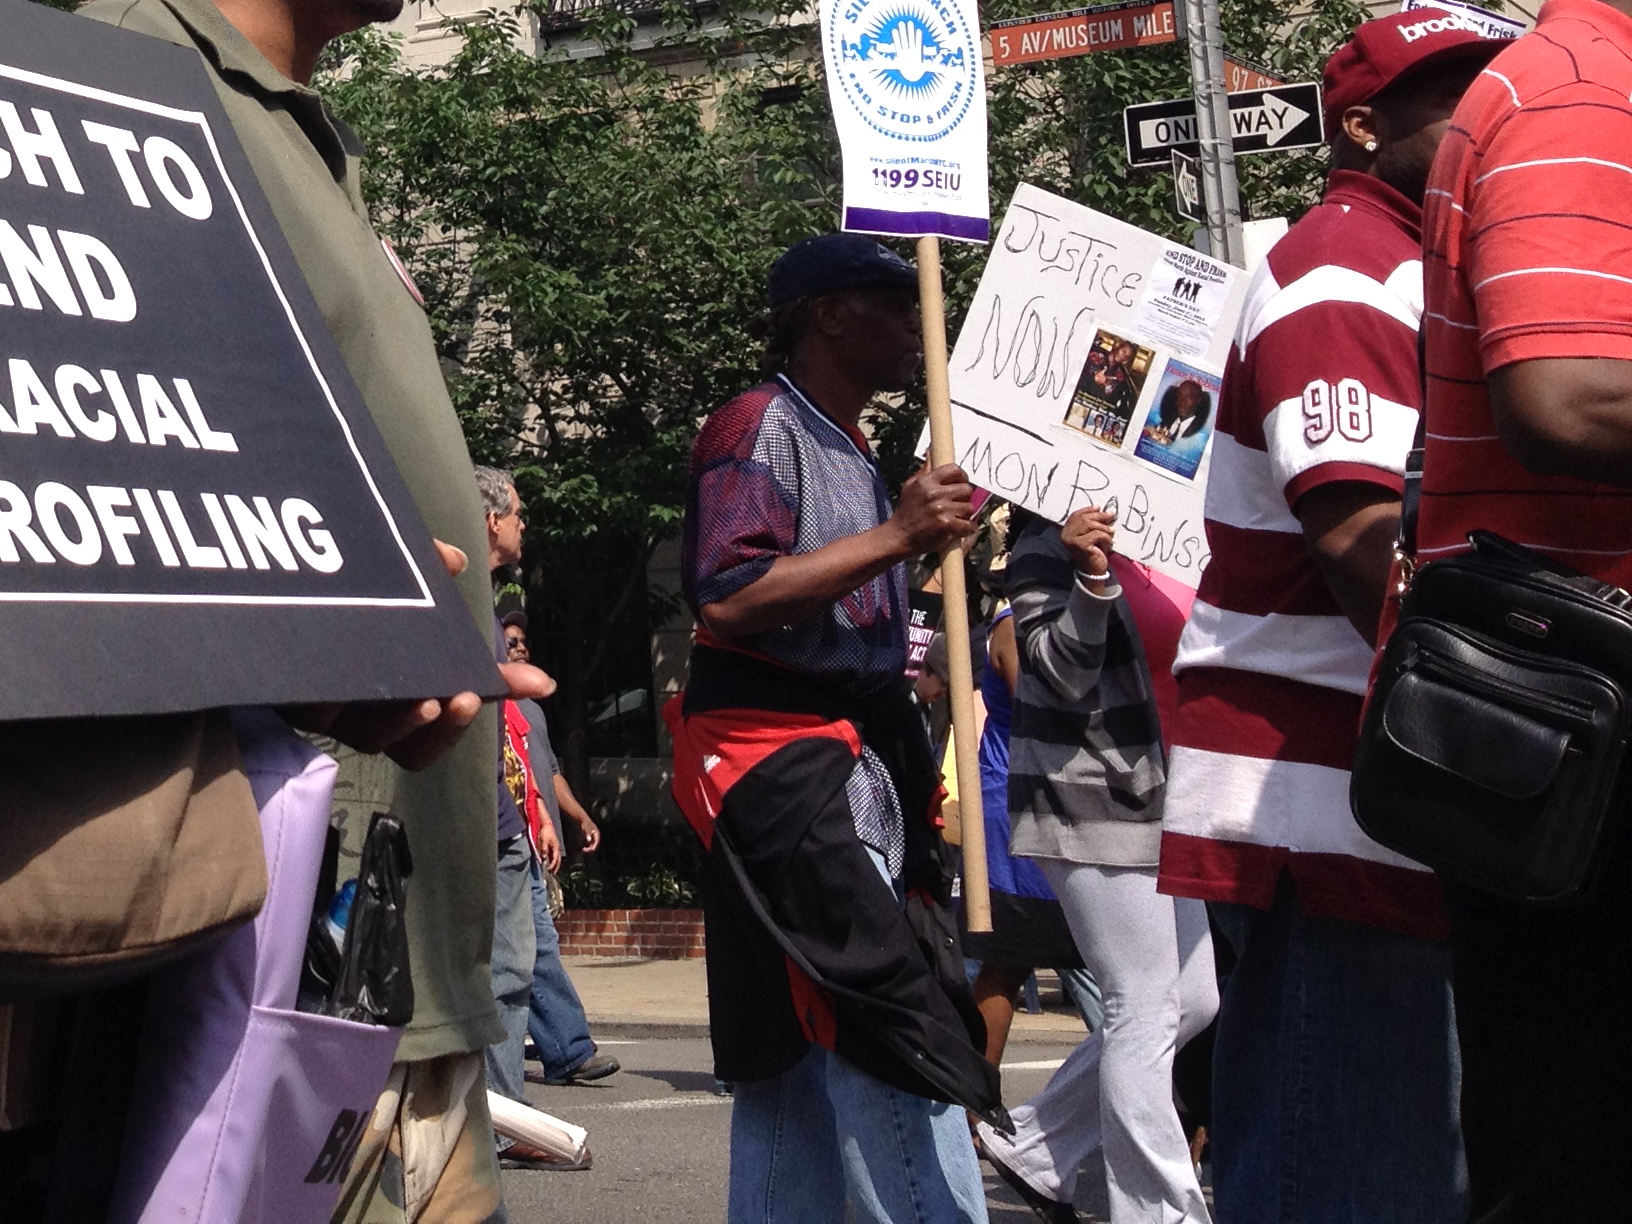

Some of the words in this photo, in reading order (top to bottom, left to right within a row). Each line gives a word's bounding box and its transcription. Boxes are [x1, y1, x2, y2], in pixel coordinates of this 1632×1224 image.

[999, 36, 1011, 58] 5
[1021, 19, 1124, 55] AV/MUSEUM
[1132, 11, 1174, 38] MILE
[1232, 66, 1248, 91] 97
[876, 105, 922, 124] STOP
[1155, 117, 1199, 143] ON
[1233, 106, 1289, 134] WAY
[81, 120, 212, 220] TO
[871, 167, 961, 191] 1199SEIU
[965, 293, 1096, 400] NOW
[1301, 376, 1373, 445] 98
[911, 608, 927, 626] THE
